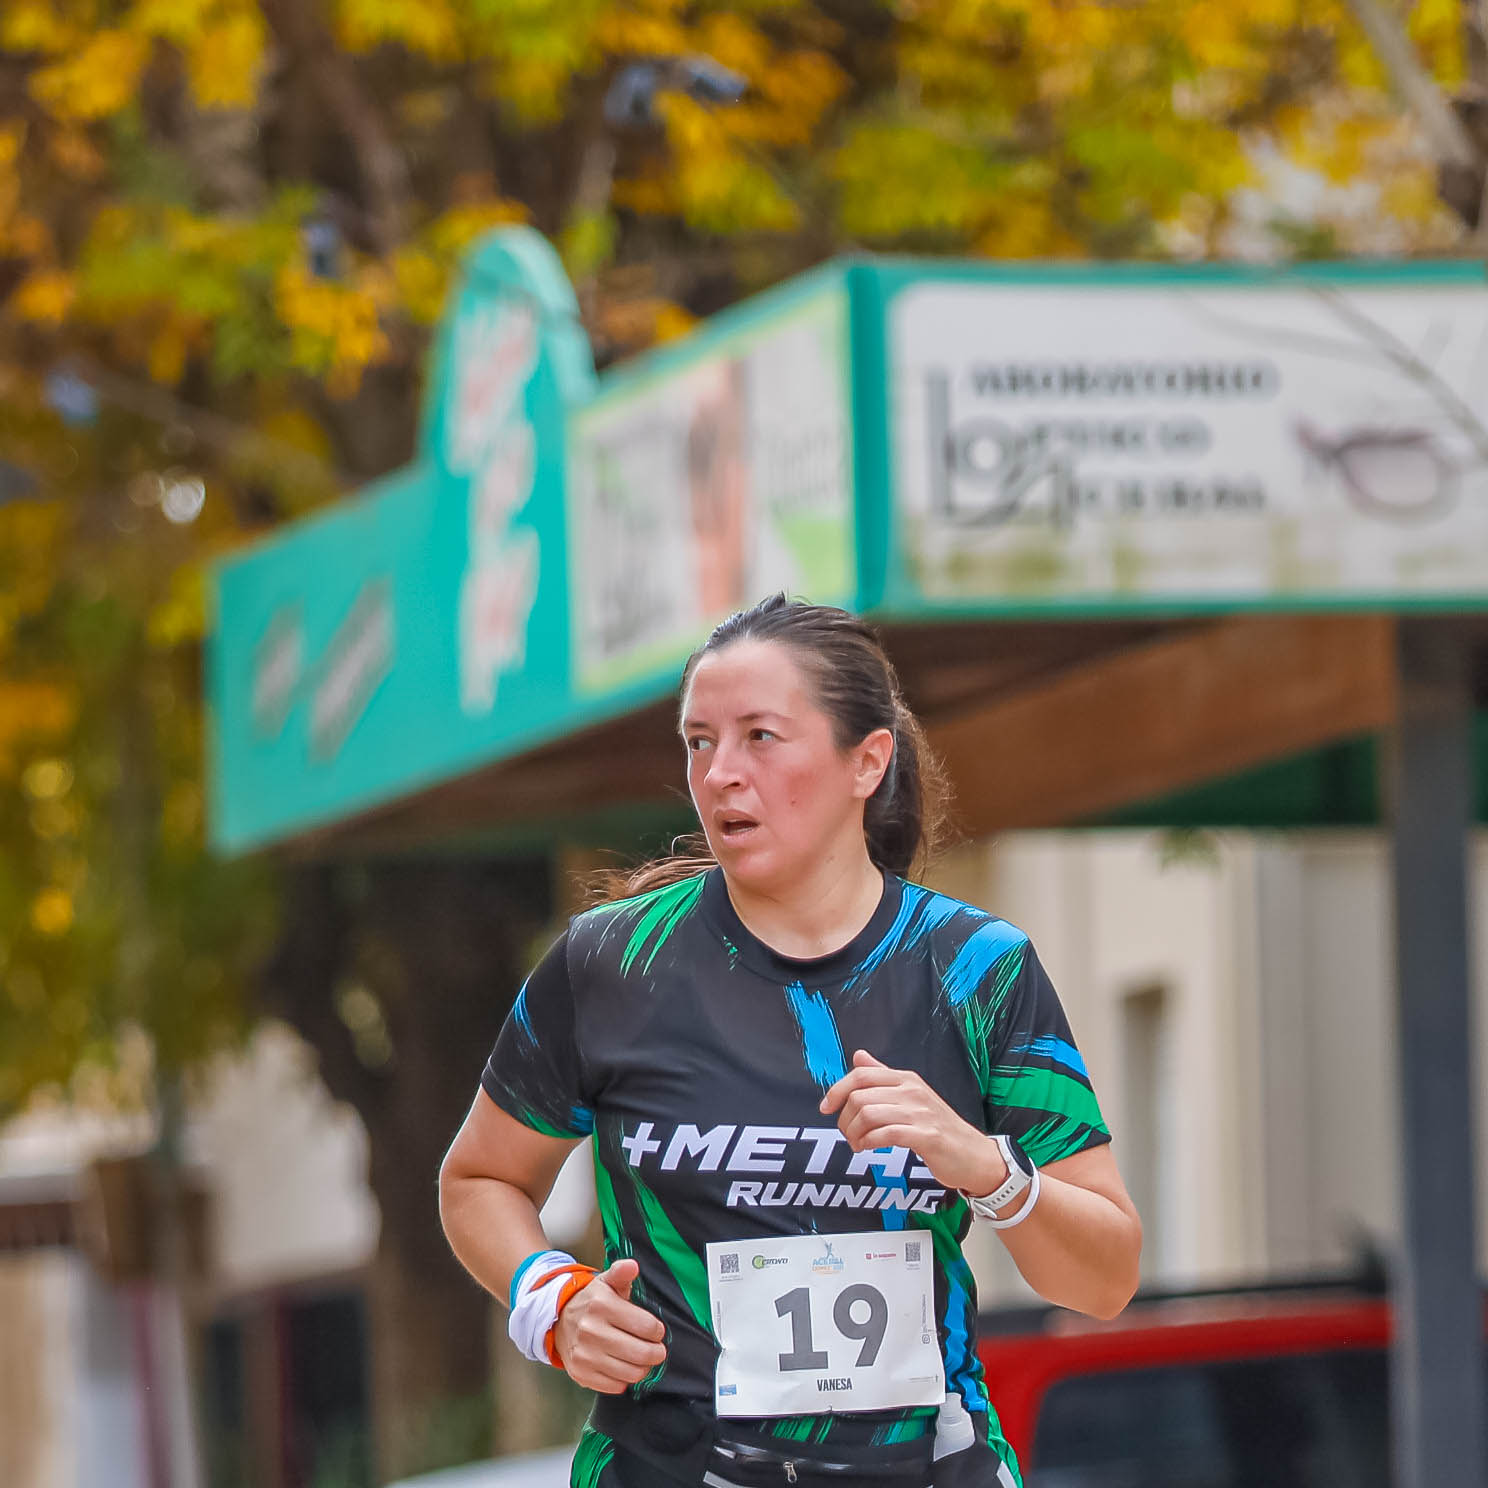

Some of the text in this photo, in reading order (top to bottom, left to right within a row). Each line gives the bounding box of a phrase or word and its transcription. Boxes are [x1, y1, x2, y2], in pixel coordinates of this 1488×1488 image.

[727, 1180, 946, 1214] RUNNING
[774, 1283, 888, 1372] 19
[817, 1378, 853, 1392] VANESA
